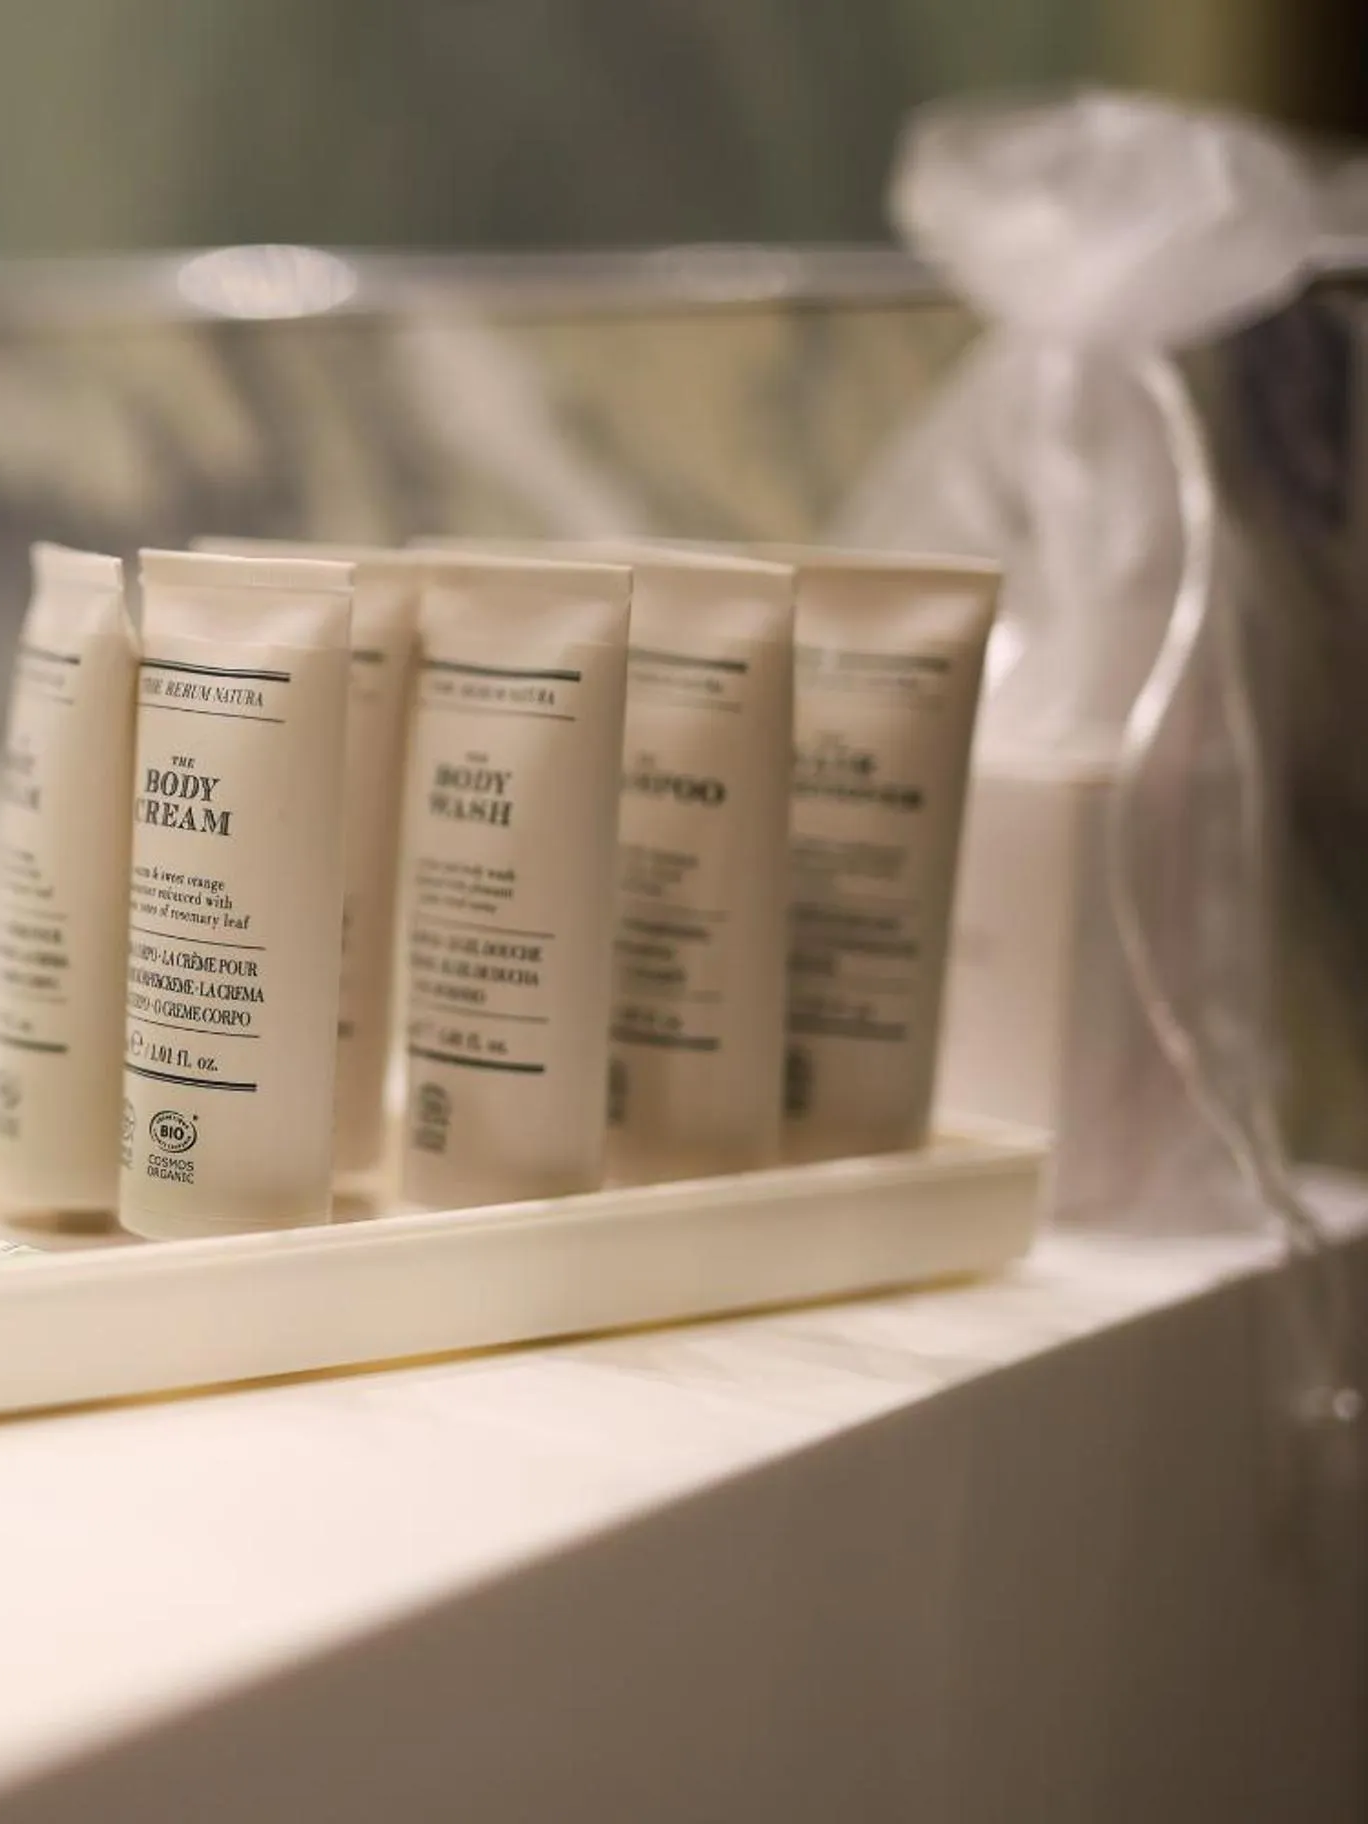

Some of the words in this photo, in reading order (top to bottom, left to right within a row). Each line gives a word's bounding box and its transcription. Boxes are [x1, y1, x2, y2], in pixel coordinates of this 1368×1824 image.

[212, 687, 264, 707] NATURA
[144, 768, 220, 801] BODY
[436, 763, 512, 796] BODY
[135, 798, 232, 836] CREAM
[429, 792, 513, 828] WASH
[186, 875, 226, 894] orange
[205, 894, 233, 910] with
[170, 907, 220, 930] rosemary
[224, 914, 251, 930] leaf
[218, 957, 259, 977] POUR
[217, 983, 265, 1003] CREMA
[202, 1006, 252, 1028] CORPO
[198, 1057, 219, 1072] oz.
[160, 1124, 185, 1141] BIO
[148, 1153, 194, 1172] COSMOS
[147, 1165, 194, 1184] ORGANIC
